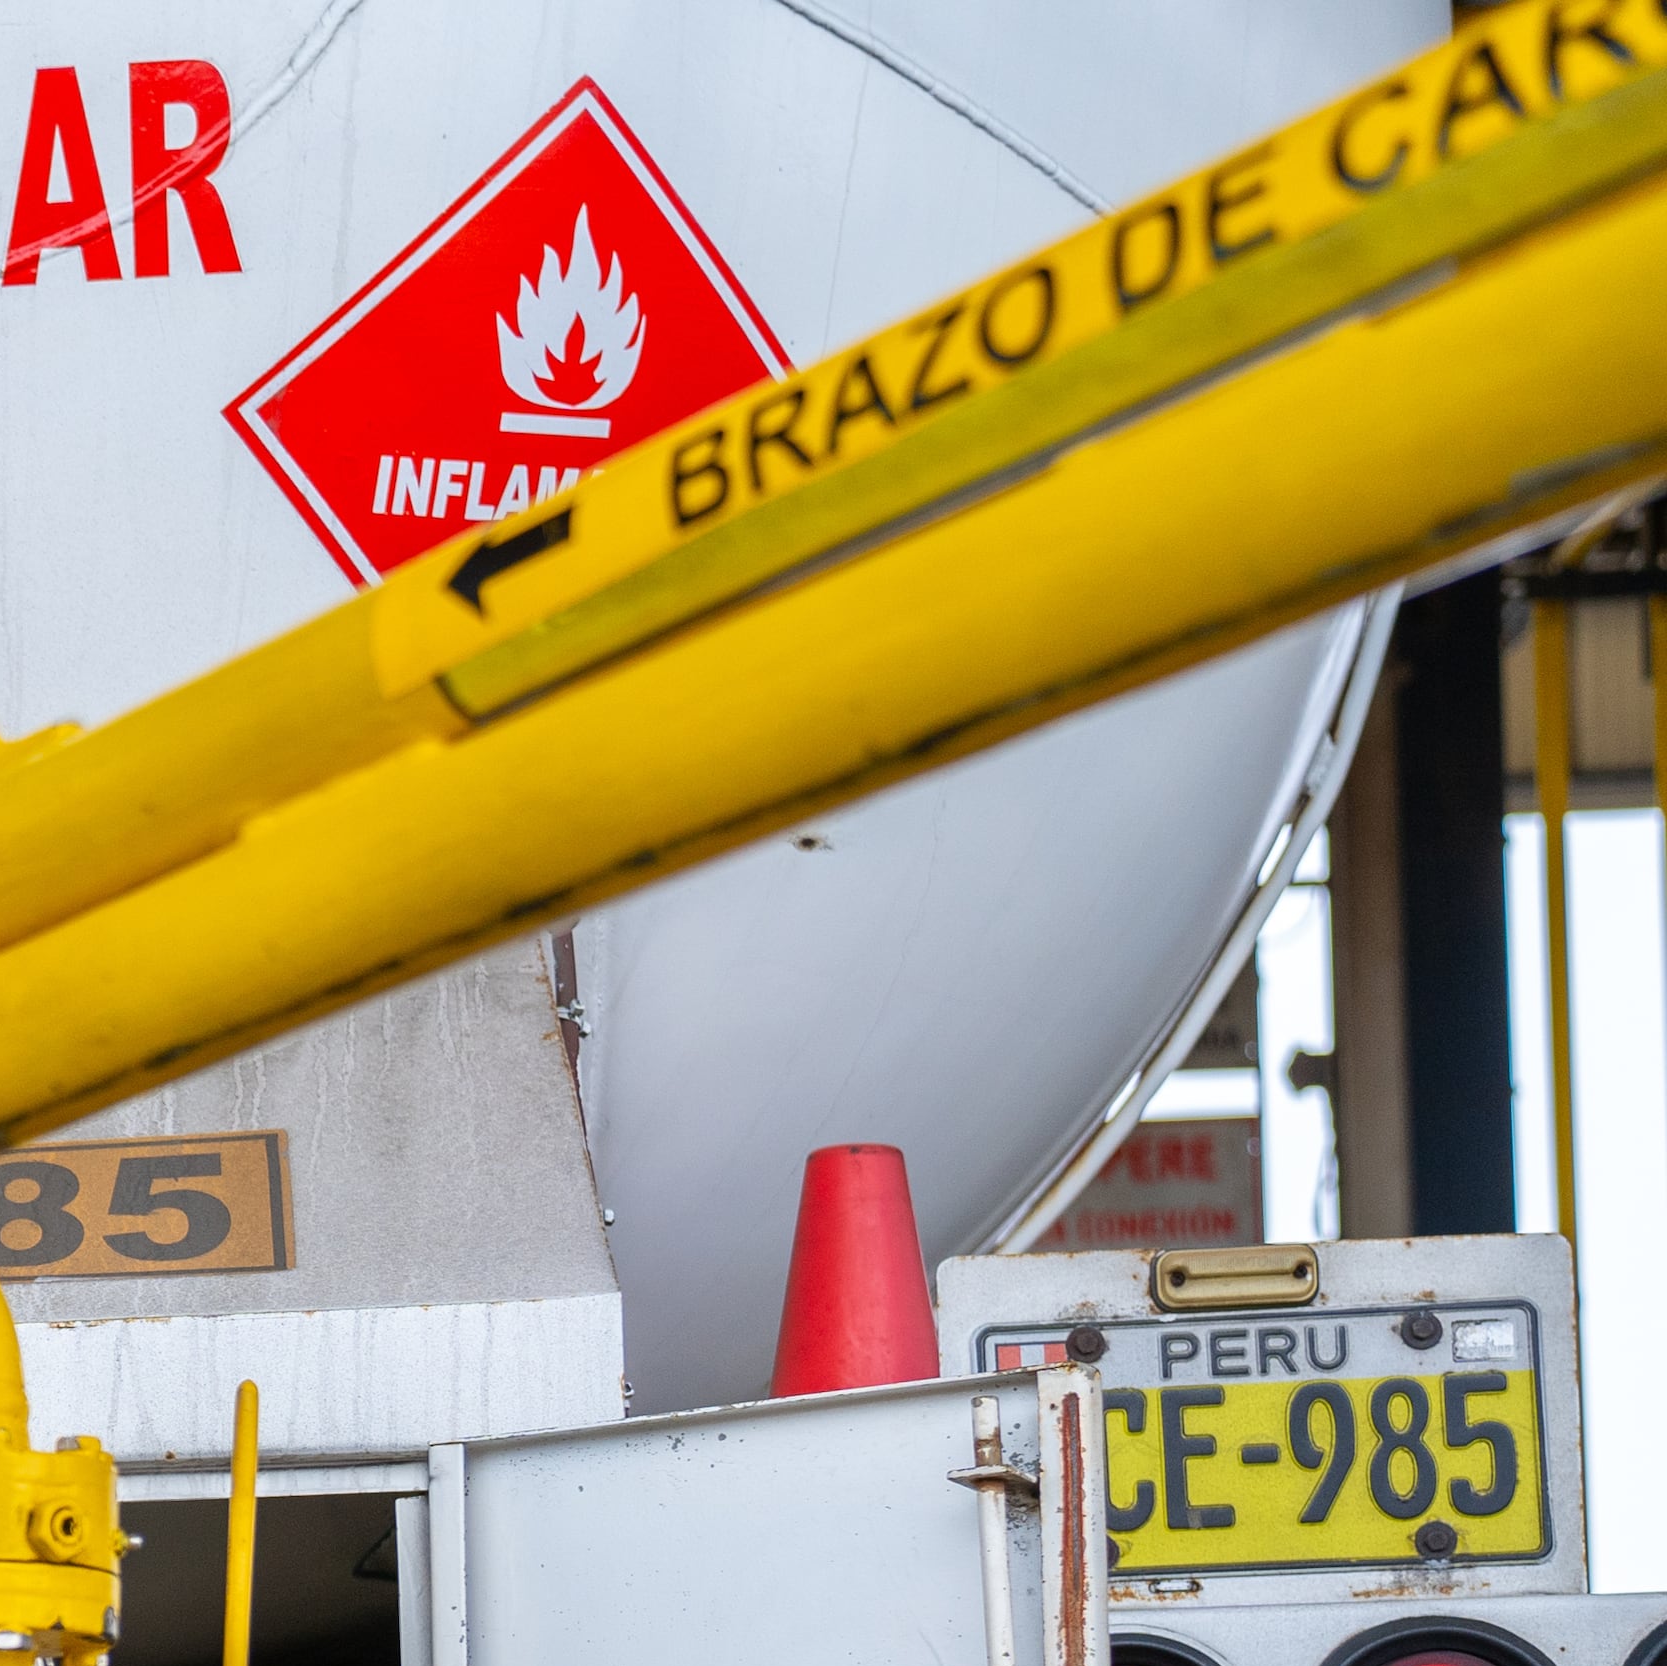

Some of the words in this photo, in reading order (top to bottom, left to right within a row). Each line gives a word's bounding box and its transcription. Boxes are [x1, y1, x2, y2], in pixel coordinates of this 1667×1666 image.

[668, 266, 1056, 530] BRAZO
[1108, 149, 1282, 315] DE
[1330, 0, 1667, 193] CAR
[371, 454, 607, 522] INFLAM
[1159, 1325, 1349, 1380] PERU
